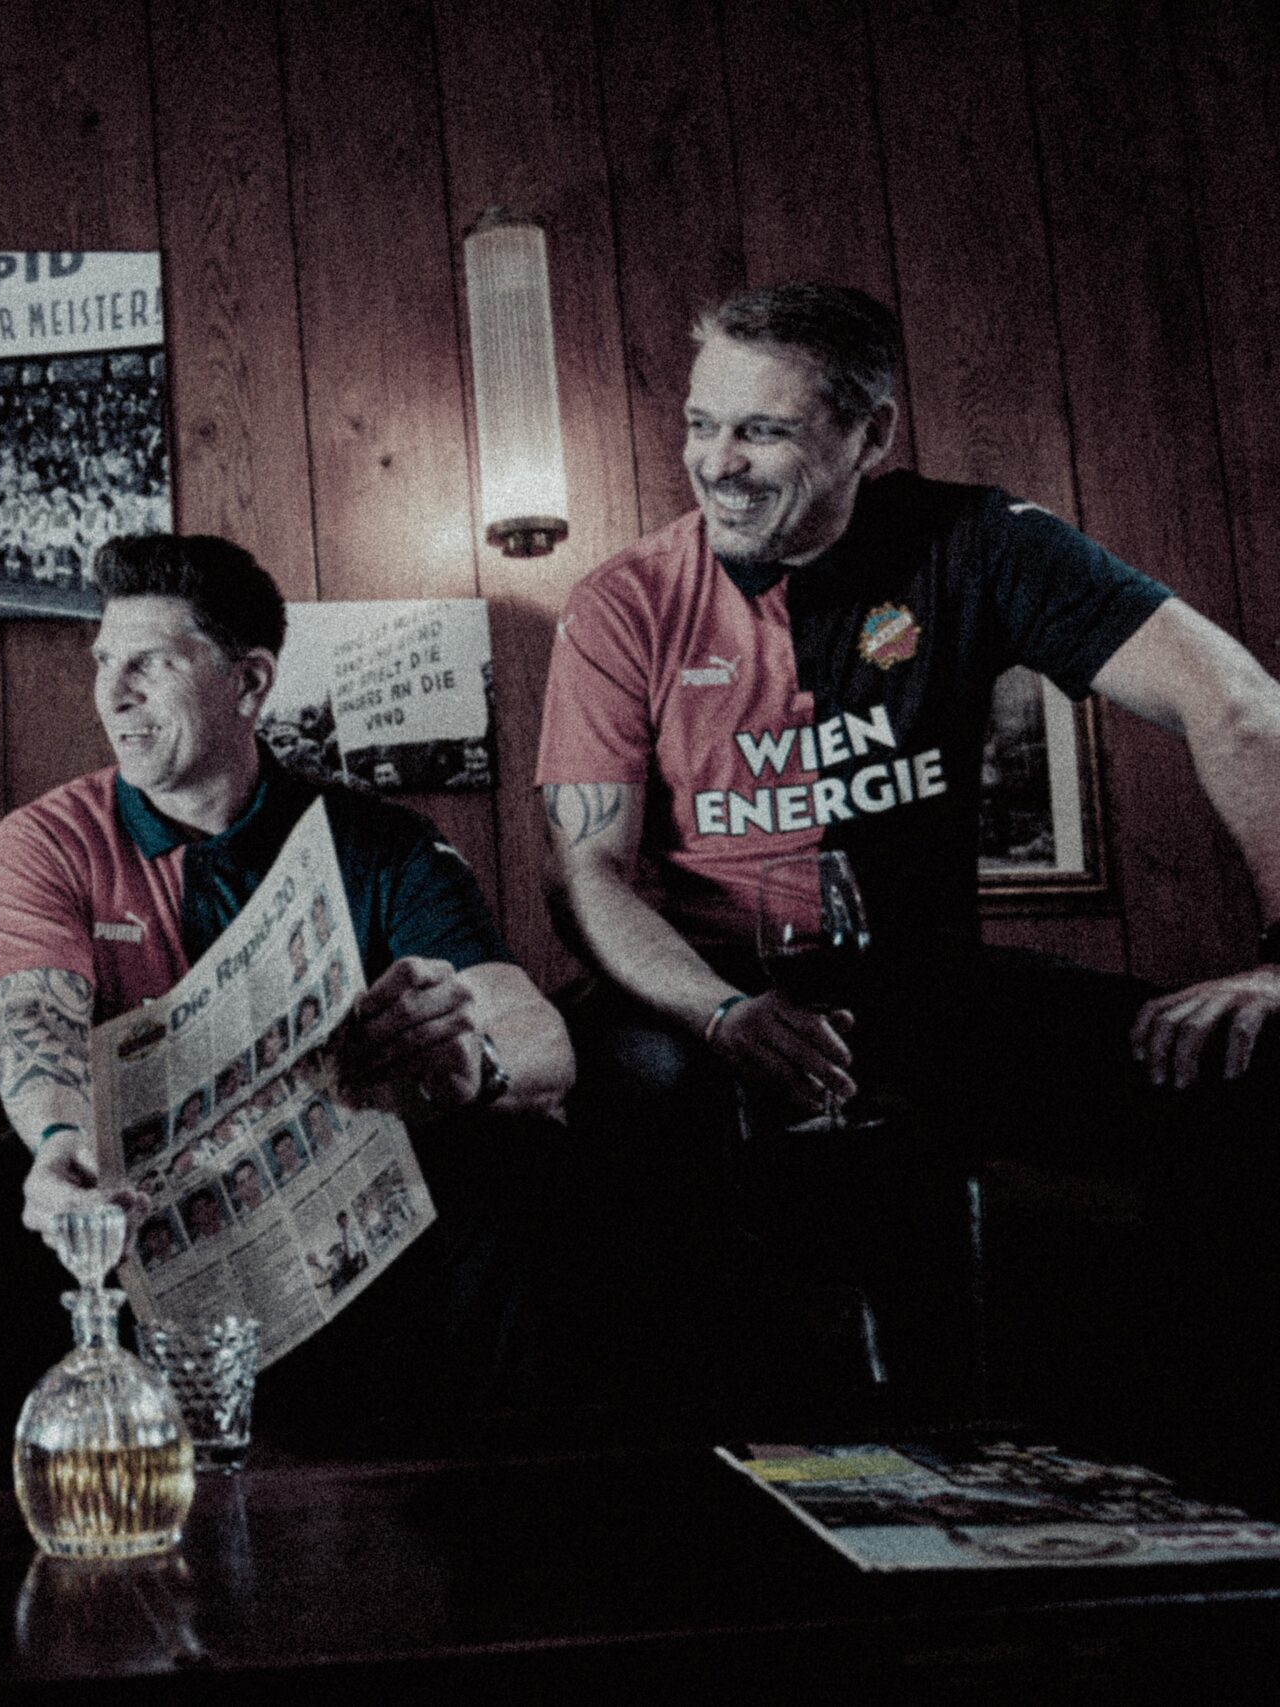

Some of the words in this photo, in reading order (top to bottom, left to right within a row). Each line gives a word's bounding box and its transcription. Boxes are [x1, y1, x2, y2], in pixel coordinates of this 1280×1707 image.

[421, 669, 455, 694] DIE
[735, 704, 897, 778] WIEN
[694, 749, 948, 836] ENERGIE
[94, 921, 142, 945] PUMA
[171, 986, 211, 1032] Die
